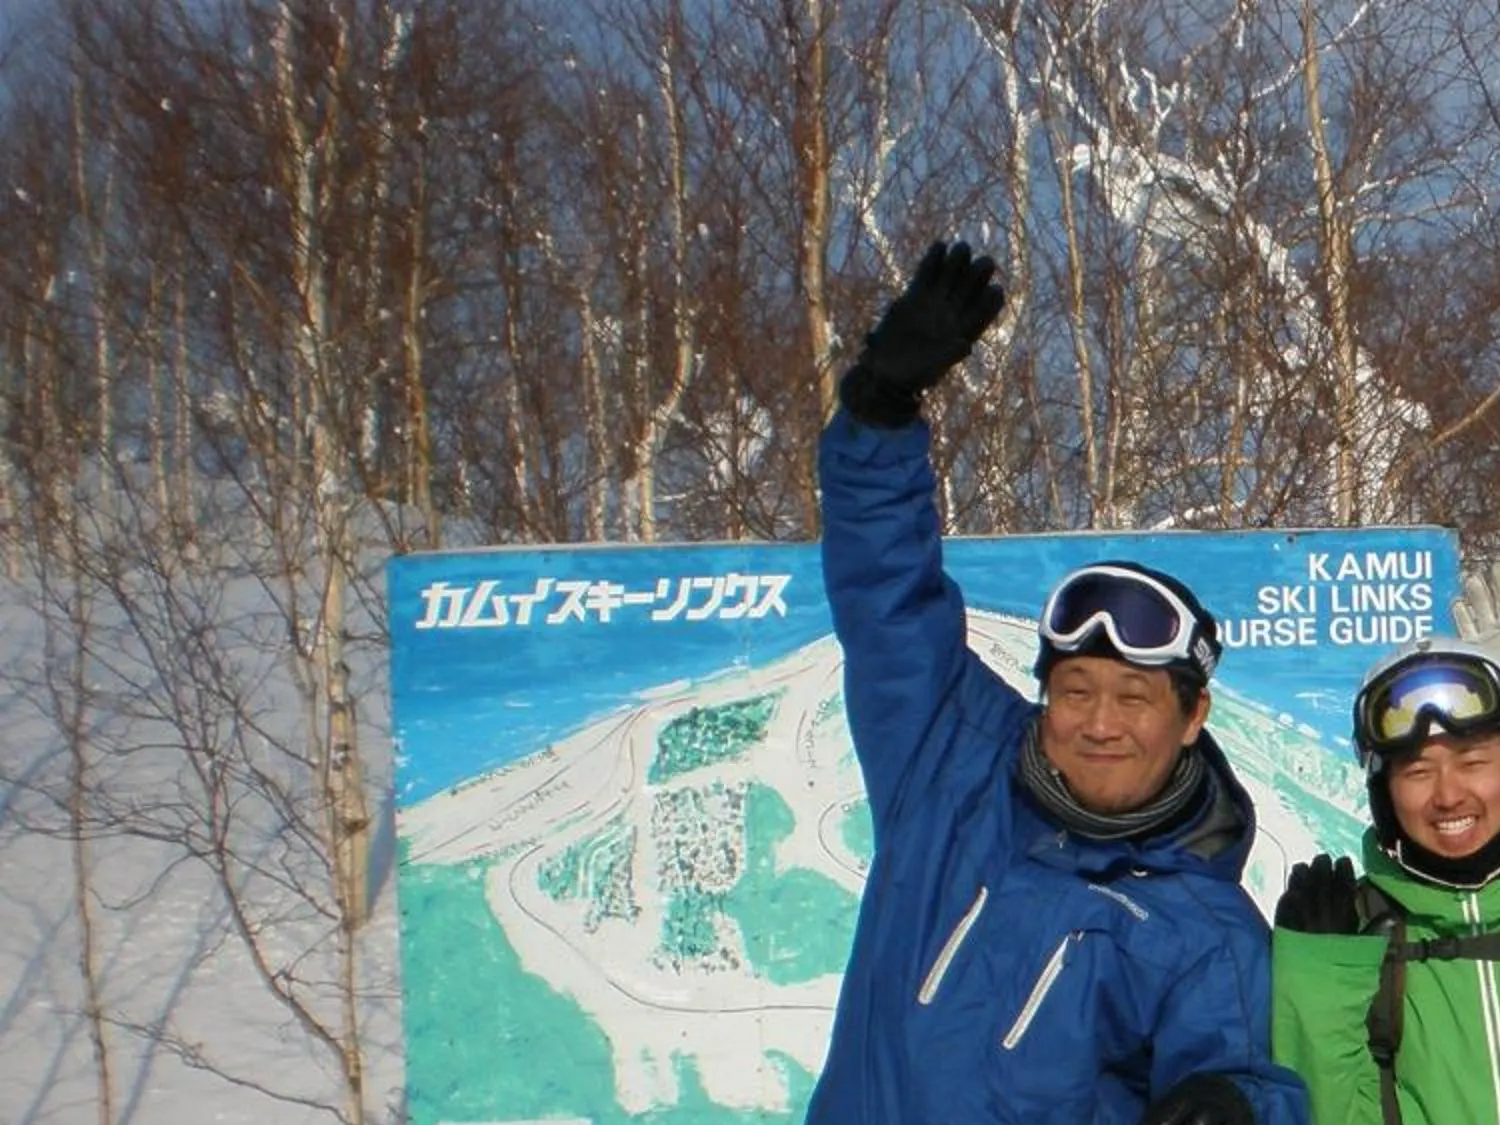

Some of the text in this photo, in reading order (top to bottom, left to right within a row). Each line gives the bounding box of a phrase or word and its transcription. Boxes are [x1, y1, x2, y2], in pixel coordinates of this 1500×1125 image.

[1308, 551, 1433, 581] KAMUI
[415, 573, 792, 629] カムイスキーリンクス
[1257, 582, 1433, 615] SKI LINKS
[1216, 615, 1433, 648] URSE GUIDE
